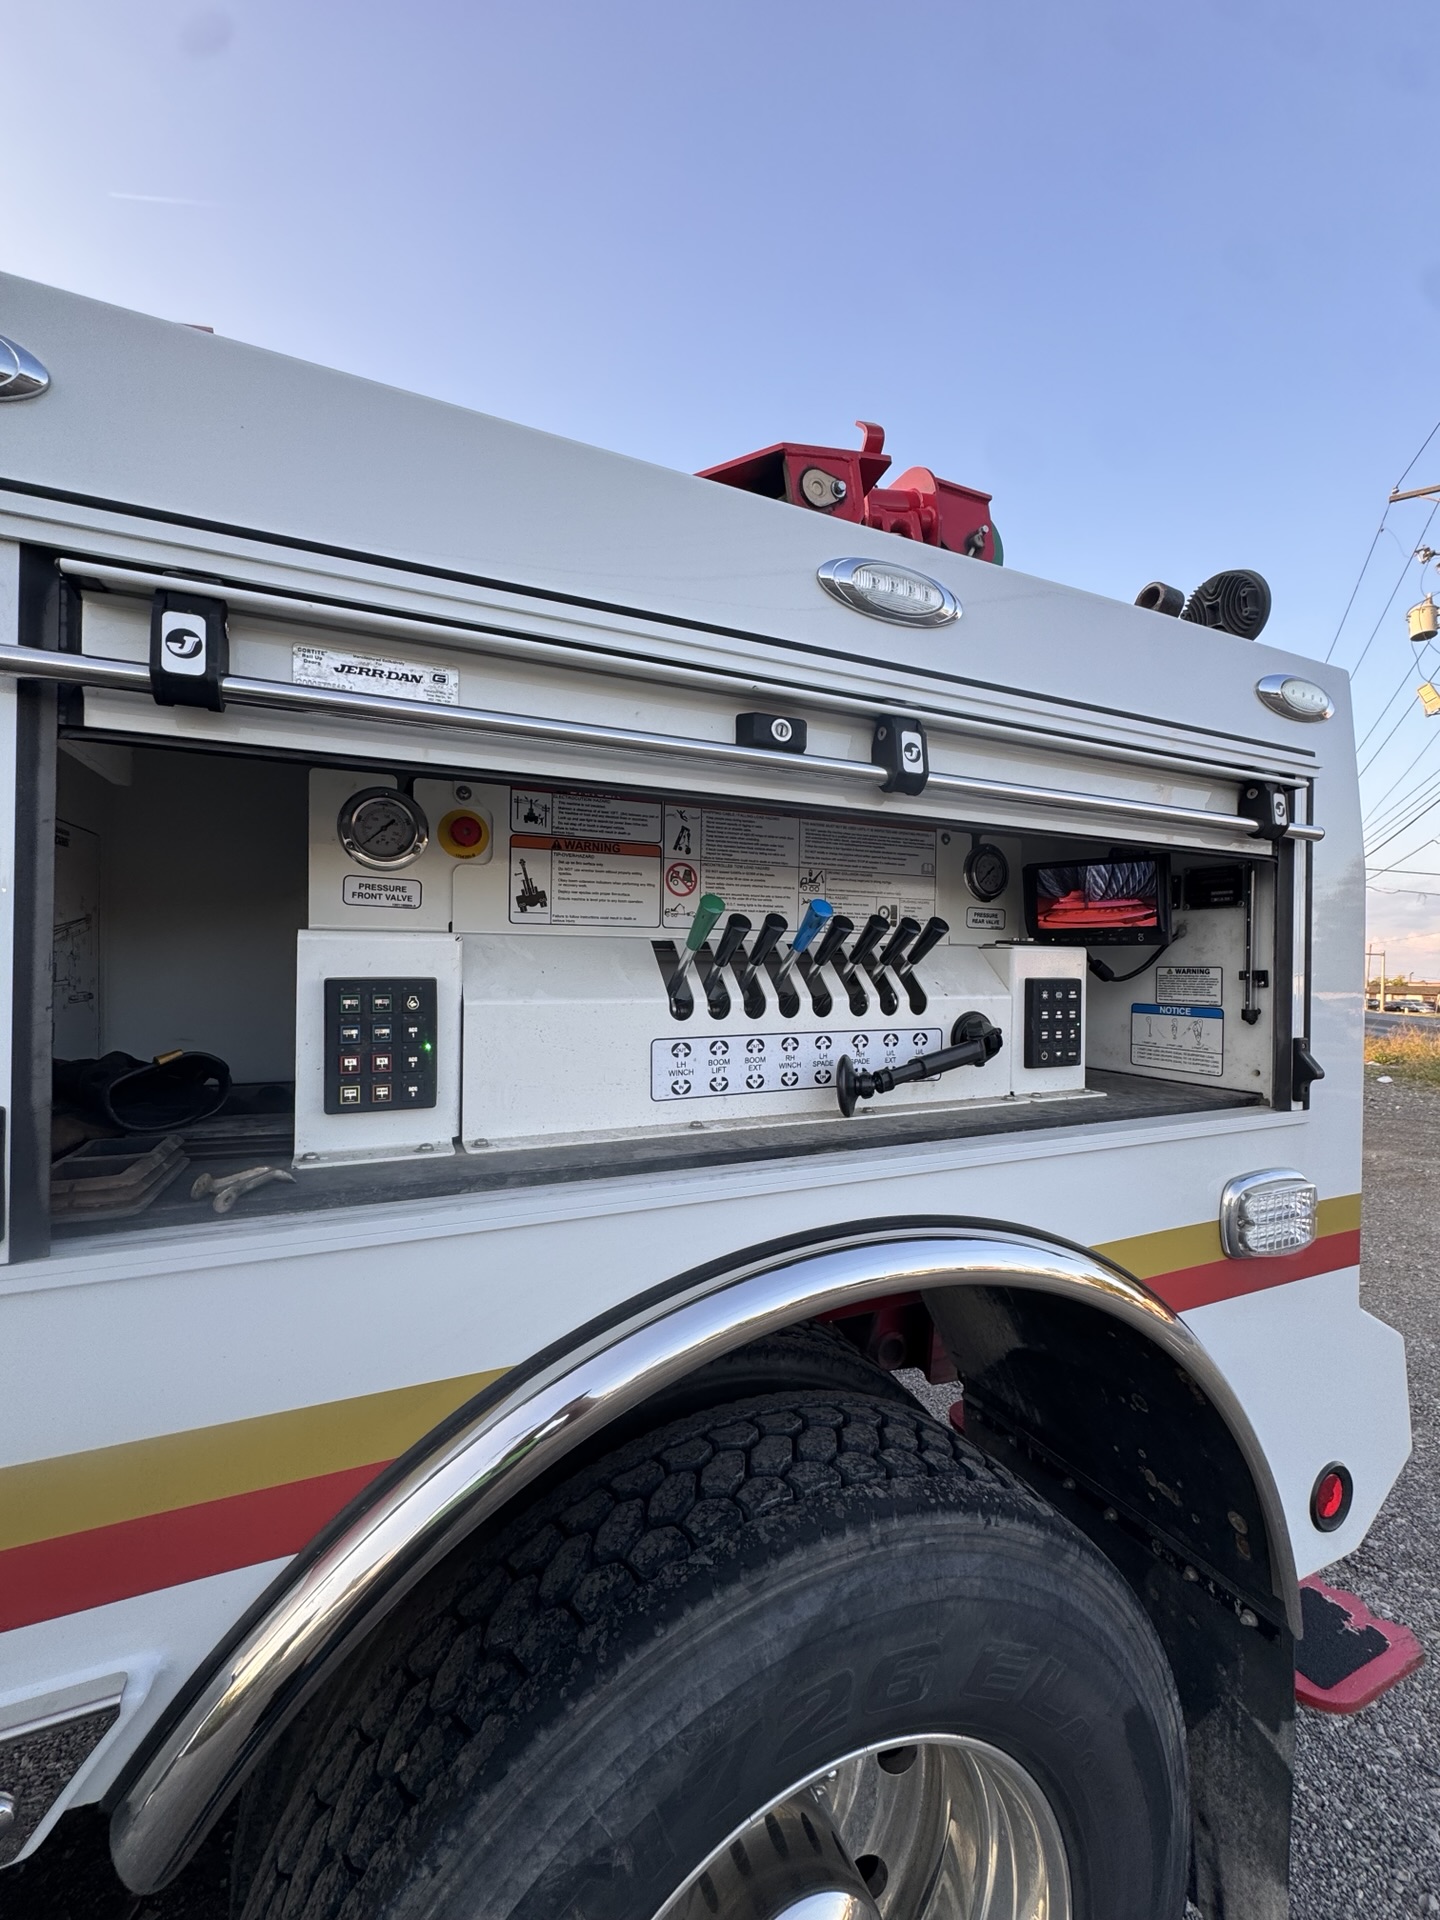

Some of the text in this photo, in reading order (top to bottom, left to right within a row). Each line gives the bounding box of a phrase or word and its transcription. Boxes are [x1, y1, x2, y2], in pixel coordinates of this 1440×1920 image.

[167, 635, 200, 655] J
[565, 841, 620, 853] WARNING
[358, 882, 407, 893] PRESSURE
[352, 892, 413, 903] FRONT VALVE
[973, 911, 999, 919] PRESSURE
[1159, 1006, 1192, 1015] NOTICE
[744, 1056, 766, 1064] BOOM
[812, 1060, 834, 1068] SPADE
[885, 1056, 897, 1064] EXT
[676, 1061, 687, 1069] LH
[779, 1061, 802, 1069] WINCH
[668, 1069, 694, 1077] WINCH
[711, 1066, 727, 1074] LIFT
